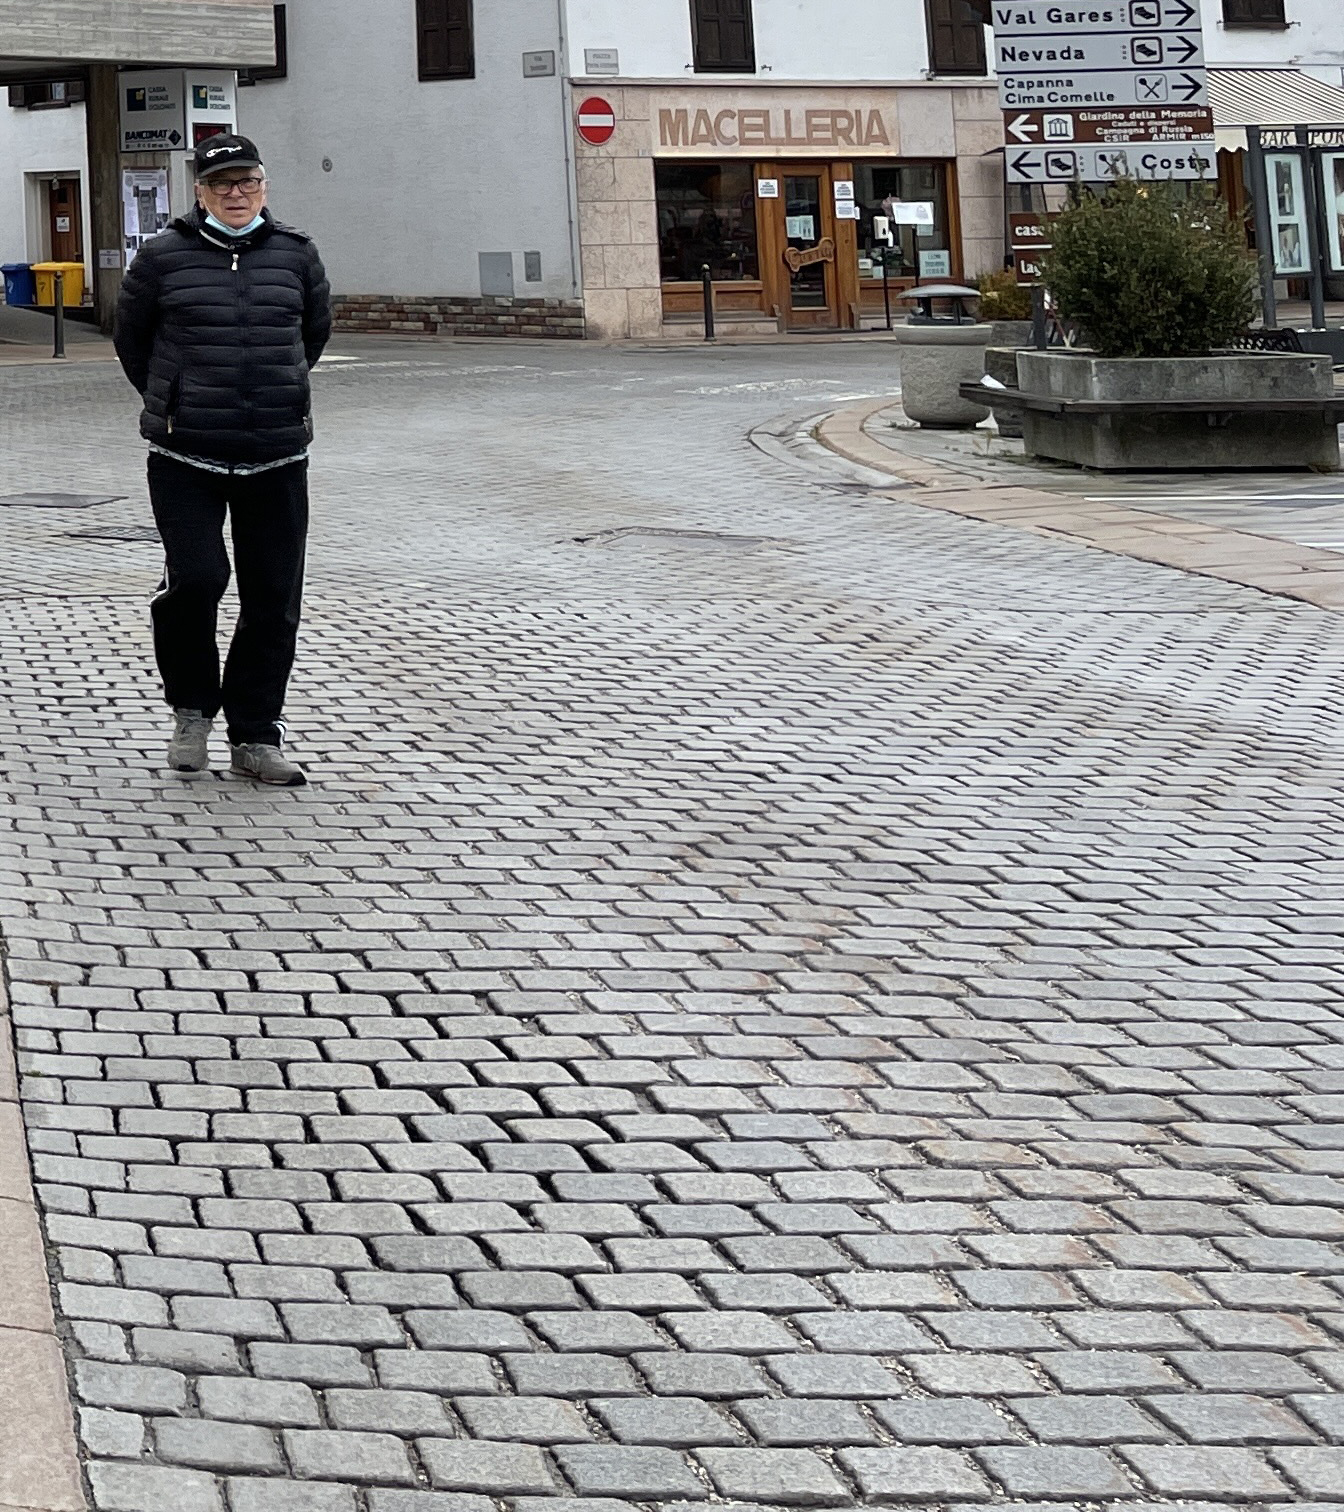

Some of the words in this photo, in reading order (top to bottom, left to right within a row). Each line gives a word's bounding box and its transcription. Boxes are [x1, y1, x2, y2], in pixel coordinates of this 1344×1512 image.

[997, 9, 1036, 25] Val
[1047, 8, 1113, 24] Gares
[1001, 45, 1085, 62] Nevada
[1004, 77, 1074, 91] Capanna
[1005, 92, 1045, 104] Cima
[1047, 91, 1115, 103] Comelle
[1079, 111, 1125, 121] Giardino
[1129, 110, 1156, 119] della
[1161, 109, 1207, 118] Memoria
[657, 107, 891, 147] MACELLERIA
[1095, 127, 1145, 135] Campagna
[1149, 126, 1158, 134] di
[1162, 125, 1193, 133] Russia
[125, 130, 167, 141] BANCOMAT
[1152, 133, 1187, 141] ARMIR
[1259, 131, 1291, 145] BAR
[1141, 154, 1211, 170] Costa
